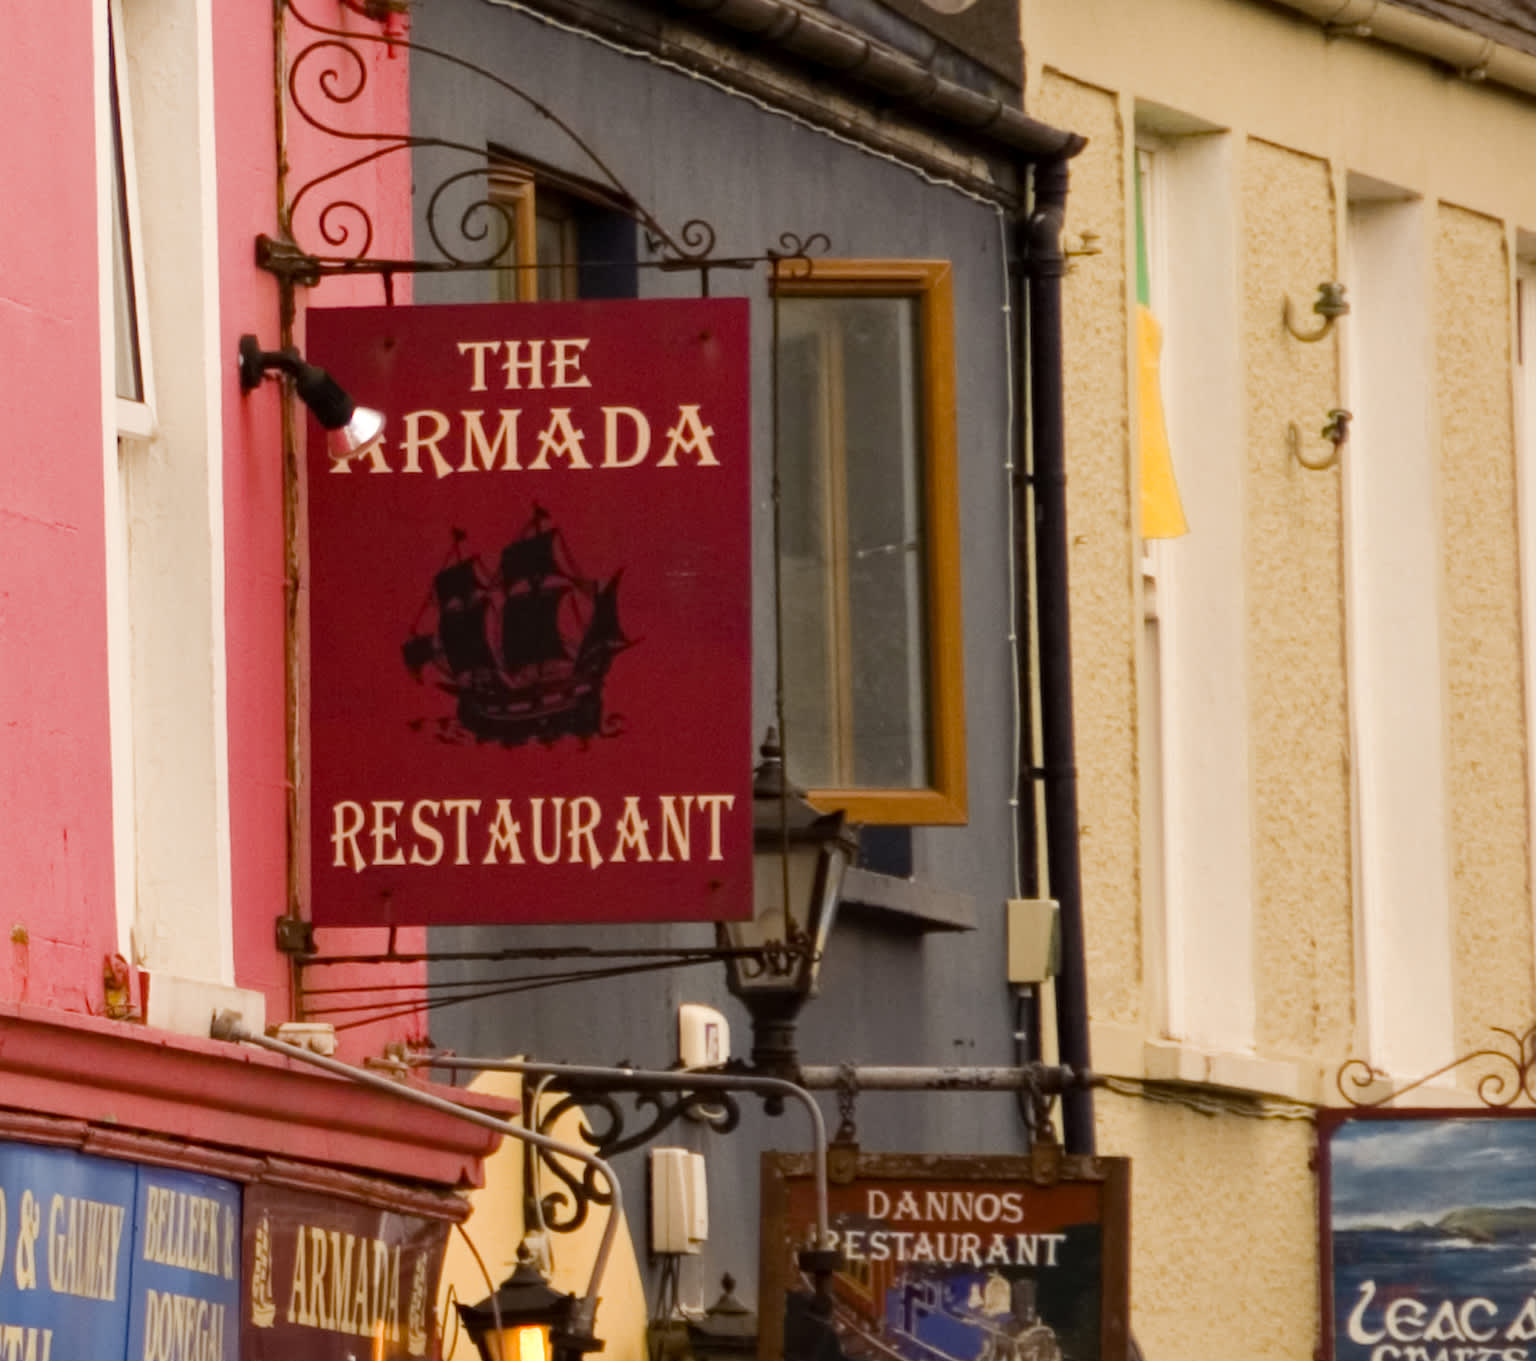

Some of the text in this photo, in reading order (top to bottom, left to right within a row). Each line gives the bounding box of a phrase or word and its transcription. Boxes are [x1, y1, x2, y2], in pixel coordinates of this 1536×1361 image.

[457, 338, 592, 392] THE
[330, 793, 736, 873] RESTAURANT
[15, 1189, 40, 1291] &
[48, 1193, 125, 1302] GALWAY
[144, 1185, 235, 1280] BELLEEK &
[867, 1190, 1025, 1224] DANNOS
[287, 1224, 400, 1342] ARMADA
